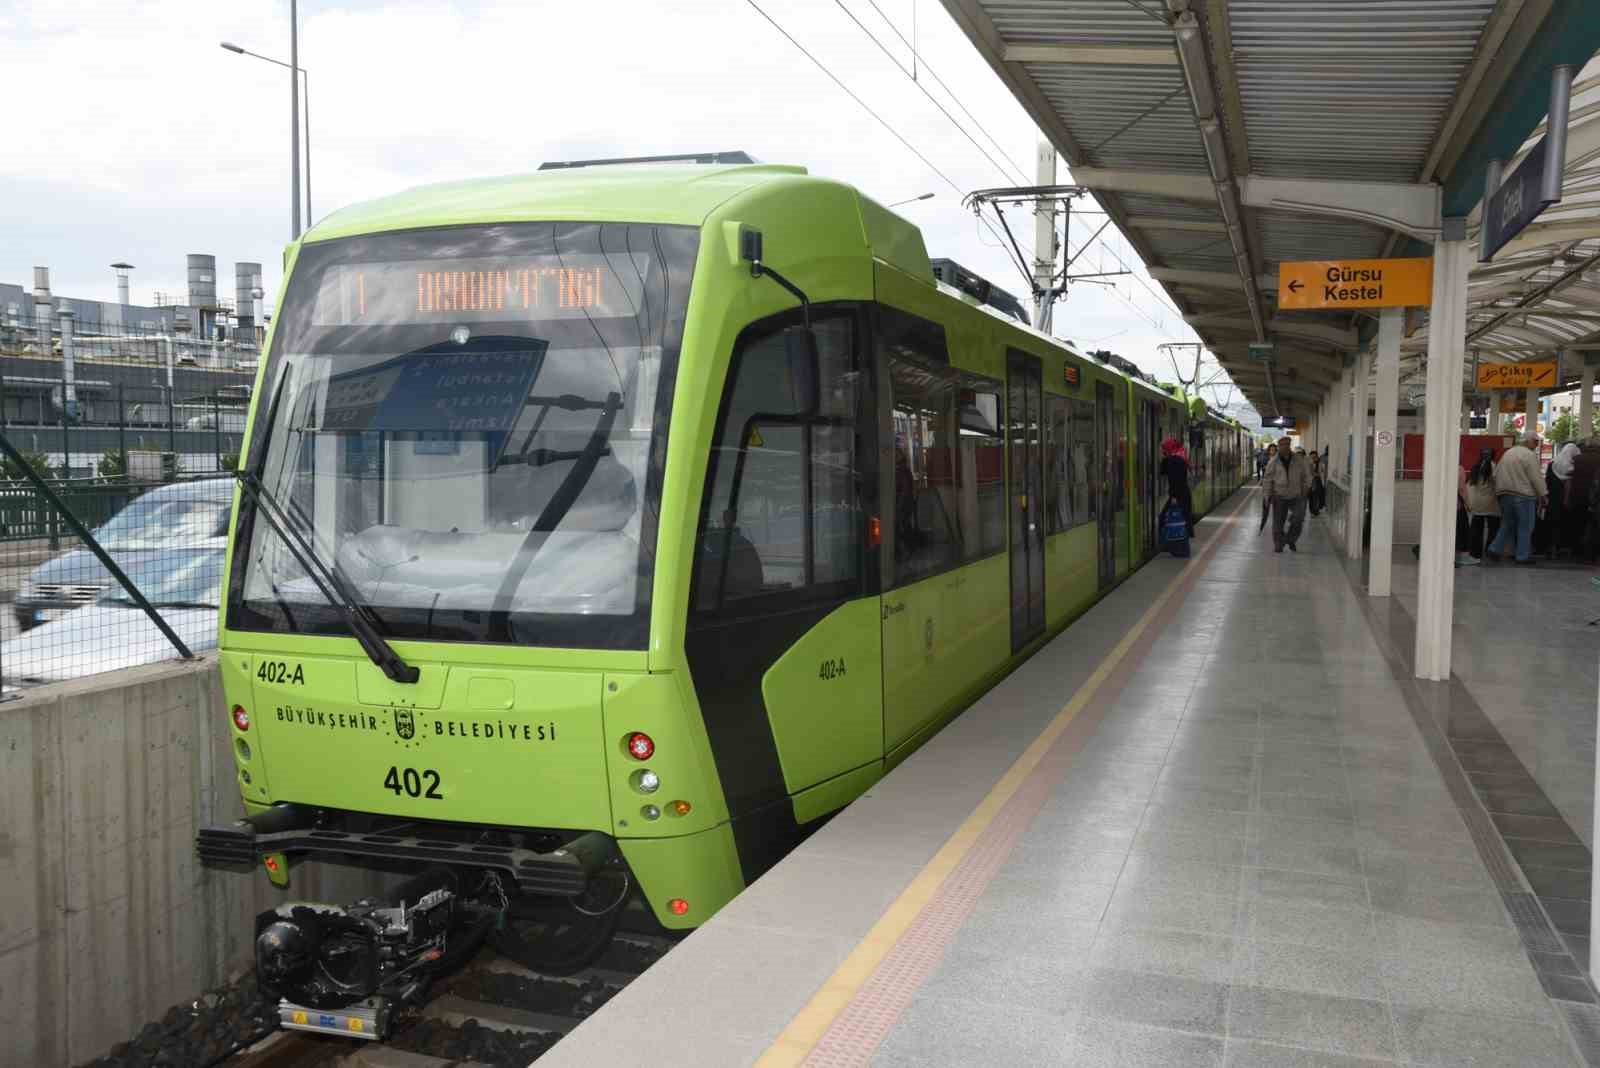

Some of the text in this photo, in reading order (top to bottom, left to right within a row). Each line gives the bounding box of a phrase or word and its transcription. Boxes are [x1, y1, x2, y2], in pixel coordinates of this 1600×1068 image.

[1326, 266, 1383, 283] Gürsu
[1324, 284, 1384, 302] Kestel
[257, 661, 305, 686] 402-A
[819, 658, 846, 680] 402-A
[276, 704, 556, 741] BÜYÜKŞEHİR BELEDİYESİ
[383, 765, 444, 800] 402
